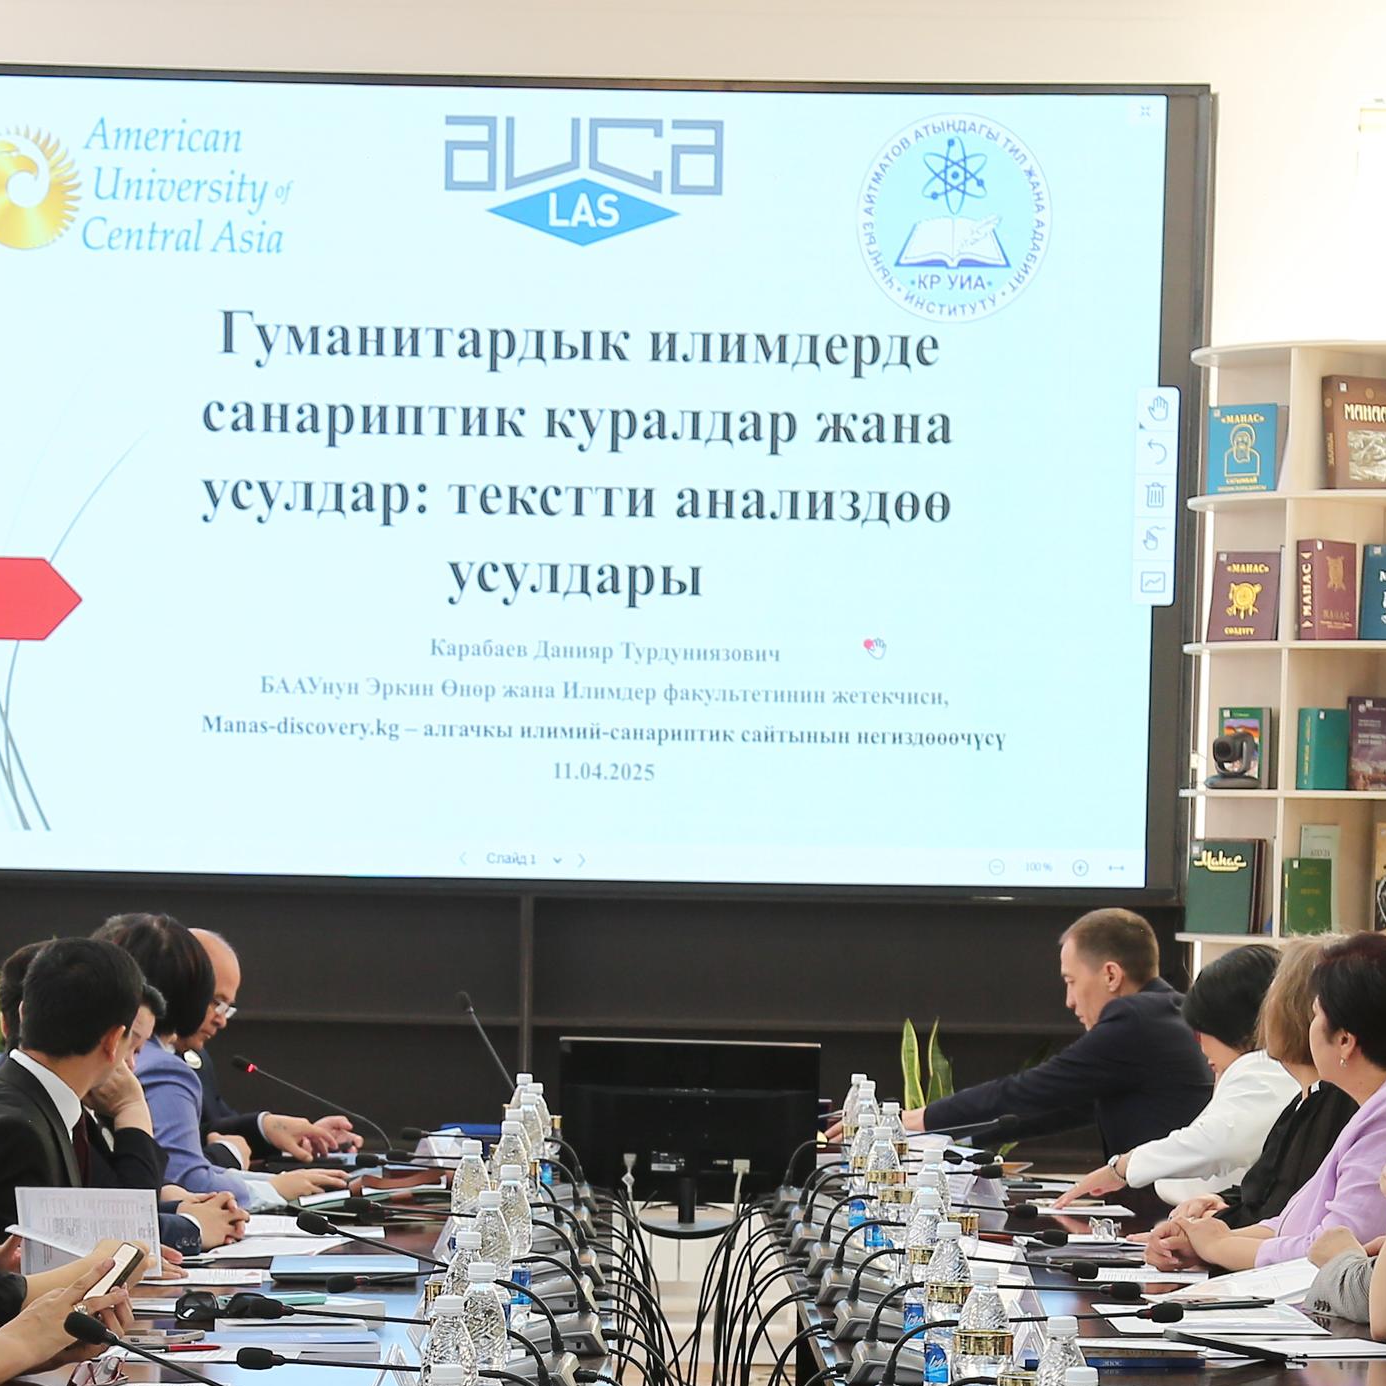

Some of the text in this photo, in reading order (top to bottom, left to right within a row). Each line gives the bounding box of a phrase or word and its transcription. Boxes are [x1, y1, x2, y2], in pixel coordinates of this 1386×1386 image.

[82, 116, 244, 153] American
[913, 120, 1001, 143] АТЫНДАГЫ
[1002, 136, 1029, 164] ТИЛ
[92, 166, 294, 216] University of
[863, 136, 912, 216] АЙТМАТОВ
[1023, 165, 1046, 214] ЖАНА
[548, 192, 621, 229] LAS
[81, 215, 285, 254] Central Asia
[1008, 218, 1046, 293] АДАБИЯТ
[917, 274, 987, 291] КР УИА
[903, 289, 998, 318] ИНСТИТУТУ
[219, 309, 940, 374] Гуманитардык илимдерде
[201, 400, 953, 453] санариптик куралдар жана
[201, 479, 952, 528] усулдар: текстти анализдөө
[447, 560, 702, 608] усулдары
[1301, 562, 1313, 617] МАНАС
[430, 638, 781, 667] Карабаев Данияр Турдуниязович
[261, 675, 950, 709] БААУнун Эркин Өнөр жана Илимдер факультетинин жетекчиси,
[202, 715, 401, 742] Manas-discovery.kg
[423, 723, 514, 740] алгачкы
[520, 723, 735, 748] илимий-санариптик
[741, 726, 851, 745] сайтынын
[554, 762, 656, 782] 11.04.2025
[486, 851, 527, 866] Слайд
